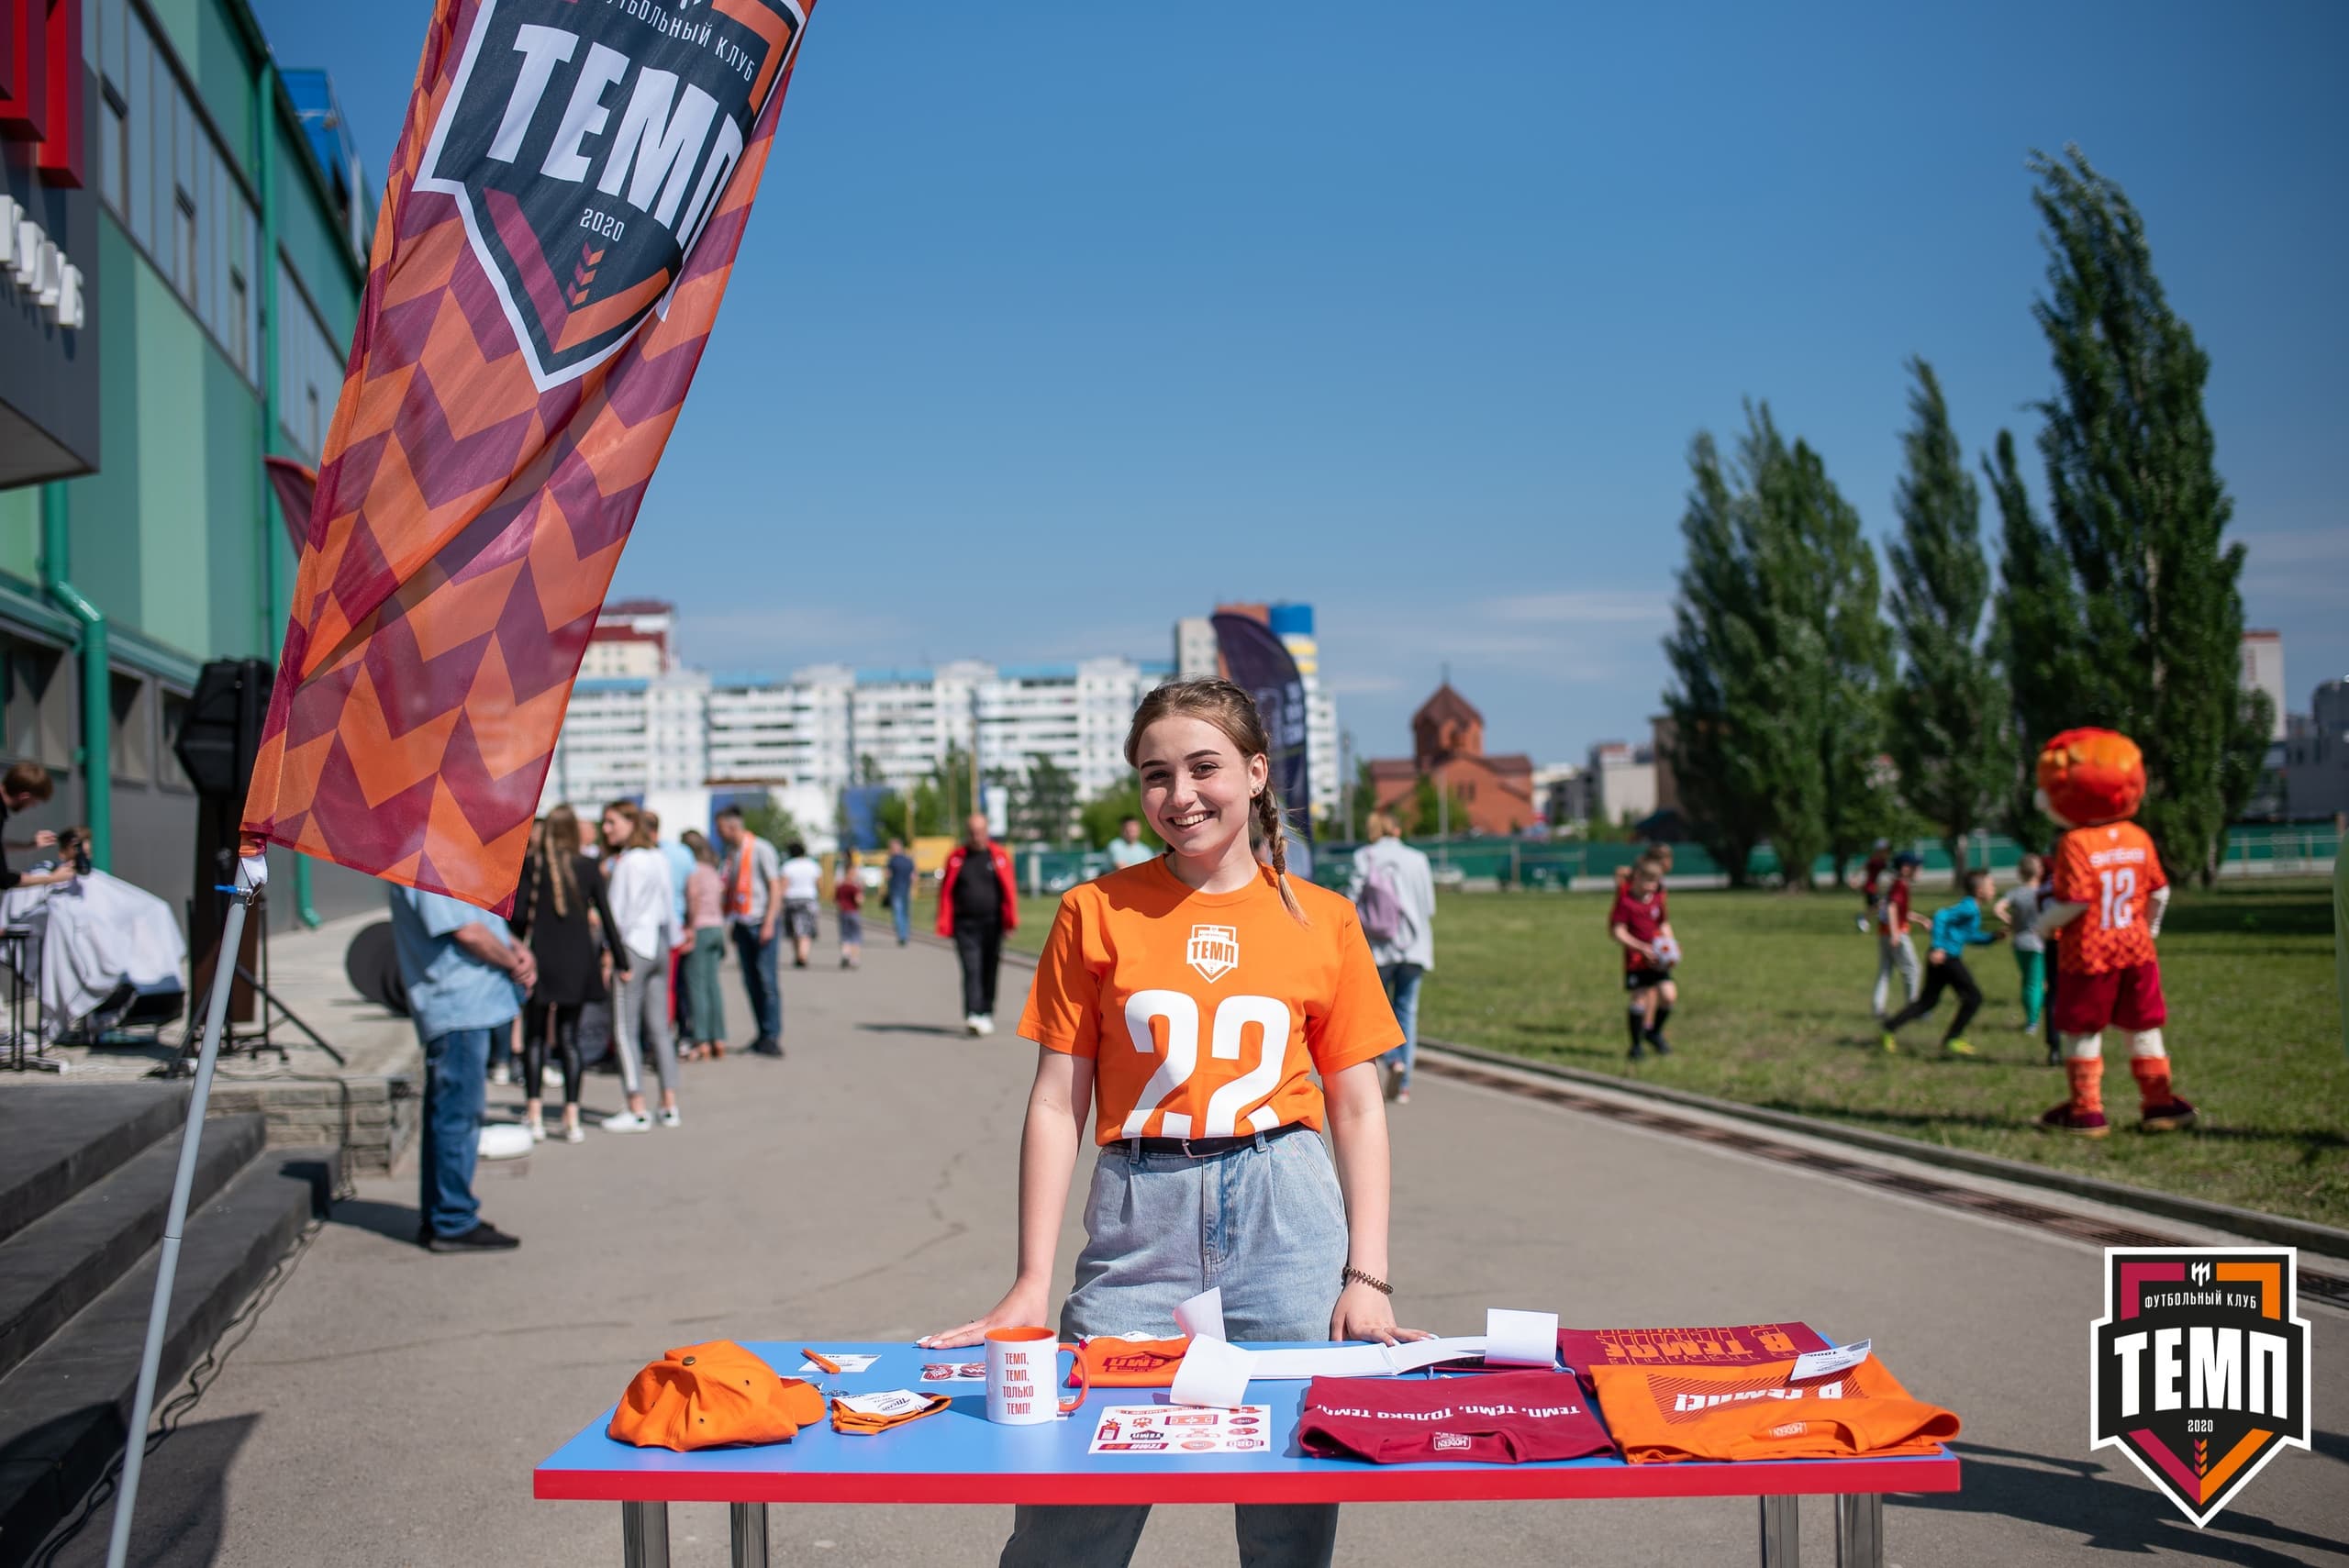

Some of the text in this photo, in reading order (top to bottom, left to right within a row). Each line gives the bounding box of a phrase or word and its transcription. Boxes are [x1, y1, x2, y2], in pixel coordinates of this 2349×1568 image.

[607, 0, 755, 82] БОЛЬНЫЙ КЛУБ
[486, 24, 743, 265] ТЕМП
[580, 207, 625, 242] 2020
[2099, 867, 2135, 931] 12
[1191, 940, 1235, 964] ТЕМП
[1121, 989, 1291, 1139] 22
[1005, 1352, 1030, 1365] ТЕМП,
[1006, 1369, 1030, 1382] ТЕМП,
[1002, 1385, 1034, 1398] ТОЛЬКО
[1007, 1402, 1030, 1416] ТЕМП!
[1376, 1407, 1454, 1421] ТОЛЬКО
